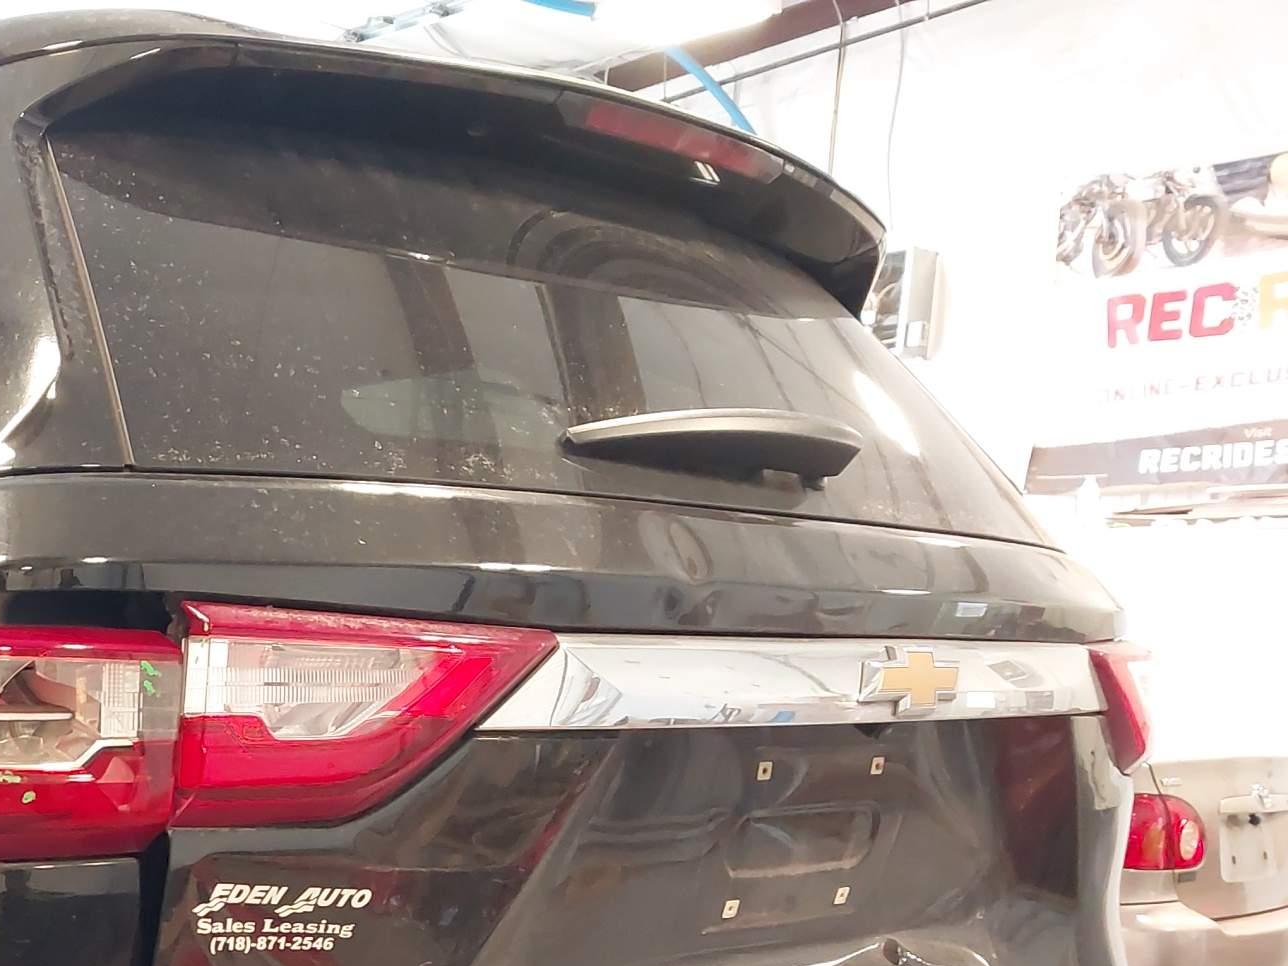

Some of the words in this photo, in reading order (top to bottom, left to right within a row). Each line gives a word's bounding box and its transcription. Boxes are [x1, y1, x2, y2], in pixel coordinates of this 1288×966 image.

[195, 883, 289, 914] EDEN
[278, 887, 373, 916] AUTO
[196, 918, 256, 935] Sales
[261, 919, 356, 938] Leasing
[209, 936, 335, 955] (718)-871-2546
